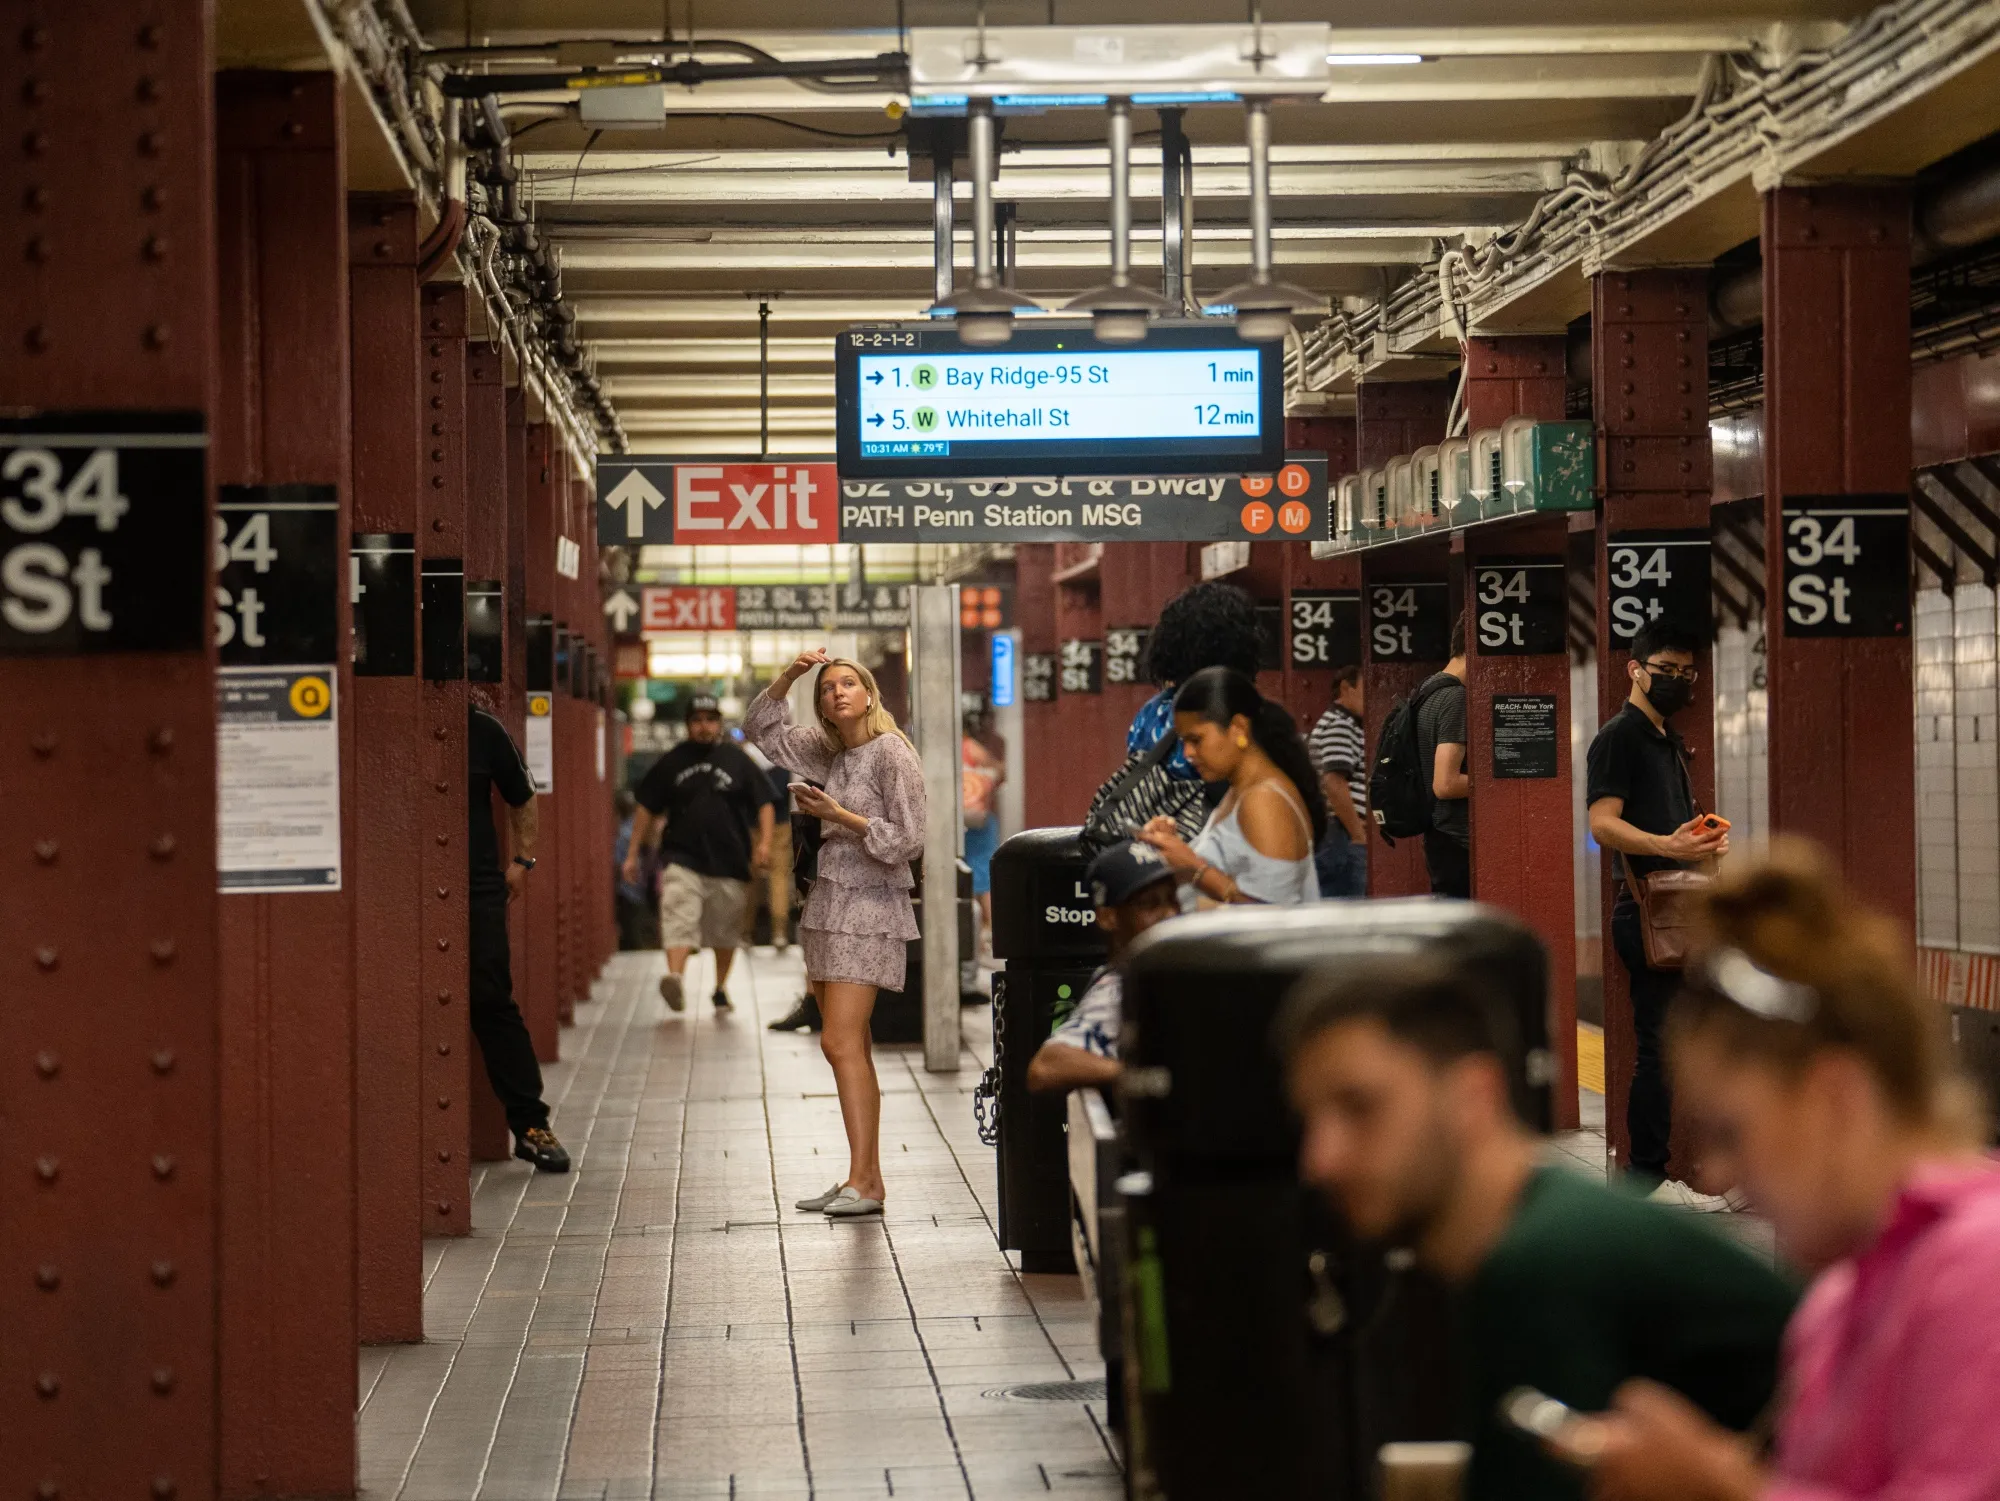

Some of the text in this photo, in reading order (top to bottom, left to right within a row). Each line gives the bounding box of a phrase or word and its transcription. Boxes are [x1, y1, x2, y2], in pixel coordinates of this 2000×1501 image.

[850, 333, 915, 346] 12-2-1-2
[892, 362, 1253, 389] 1. R Bay Ridge-95 St 1 min
[892, 404, 1254, 430] 5. W Whitehall St 12 min
[865, 444, 890, 453] 10:31
[893, 443, 908, 452] AM
[1, 449, 130, 533] 34
[1131, 478, 1226, 502] Bway
[1287, 472, 1303, 490] D
[676, 466, 819, 531] Exit
[842, 503, 1142, 528] PATH Penn Station MSG
[1251, 508, 1304, 527] F M
[1787, 517, 1861, 567] 34
[1611, 548, 1672, 588] 34
[1, 543, 113, 634] St
[1478, 570, 1531, 605] 34
[1787, 573, 1852, 626] St
[643, 588, 727, 627] Exit
[1292, 601, 1334, 629] 34
[1372, 587, 1418, 618] 34
[1611, 595, 1665, 637] St
[1373, 624, 1413, 655] St
[1479, 611, 1525, 647] St
[1106, 631, 1140, 657] 34
[1293, 633, 1329, 662] St
[1106, 658, 1136, 682] St
[300, 686, 321, 708] Q
